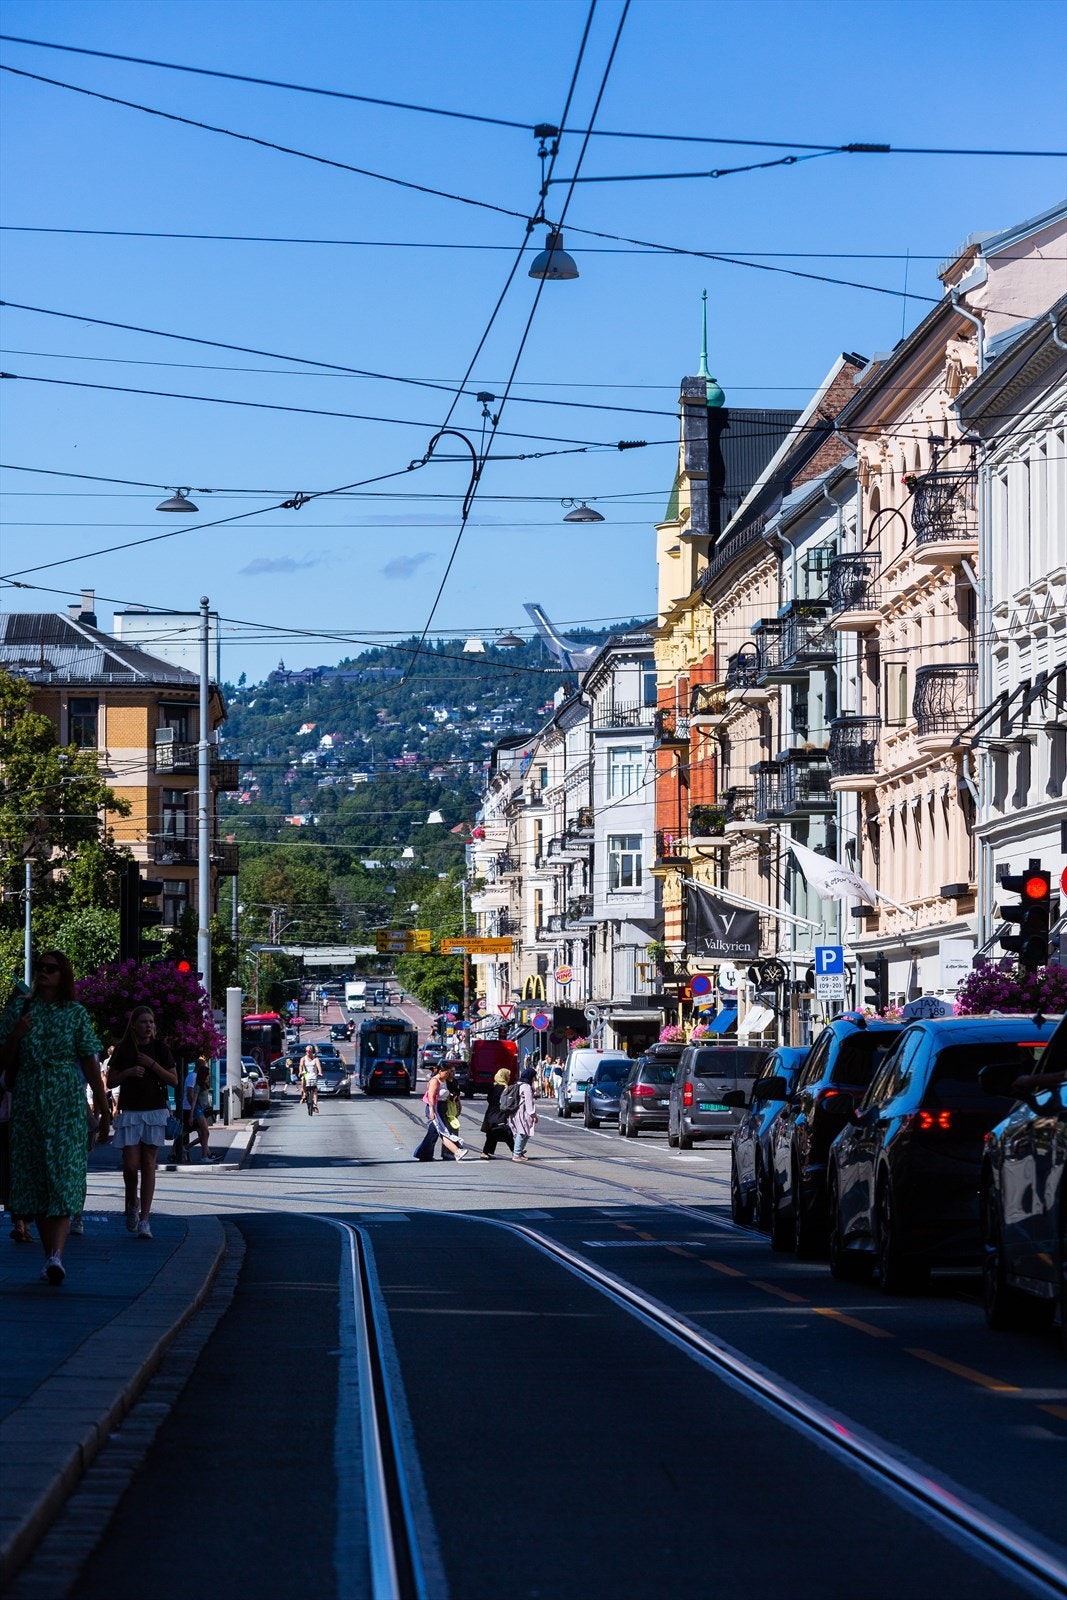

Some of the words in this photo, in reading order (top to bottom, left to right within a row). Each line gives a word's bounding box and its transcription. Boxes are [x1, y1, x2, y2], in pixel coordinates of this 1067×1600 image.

[704, 938, 751, 953] Valkyrien
[822, 950, 837, 971] P
[556, 972, 573, 981] KING
[911, 1007, 925, 1015] VT
[929, 1007, 946, 1016] 189
